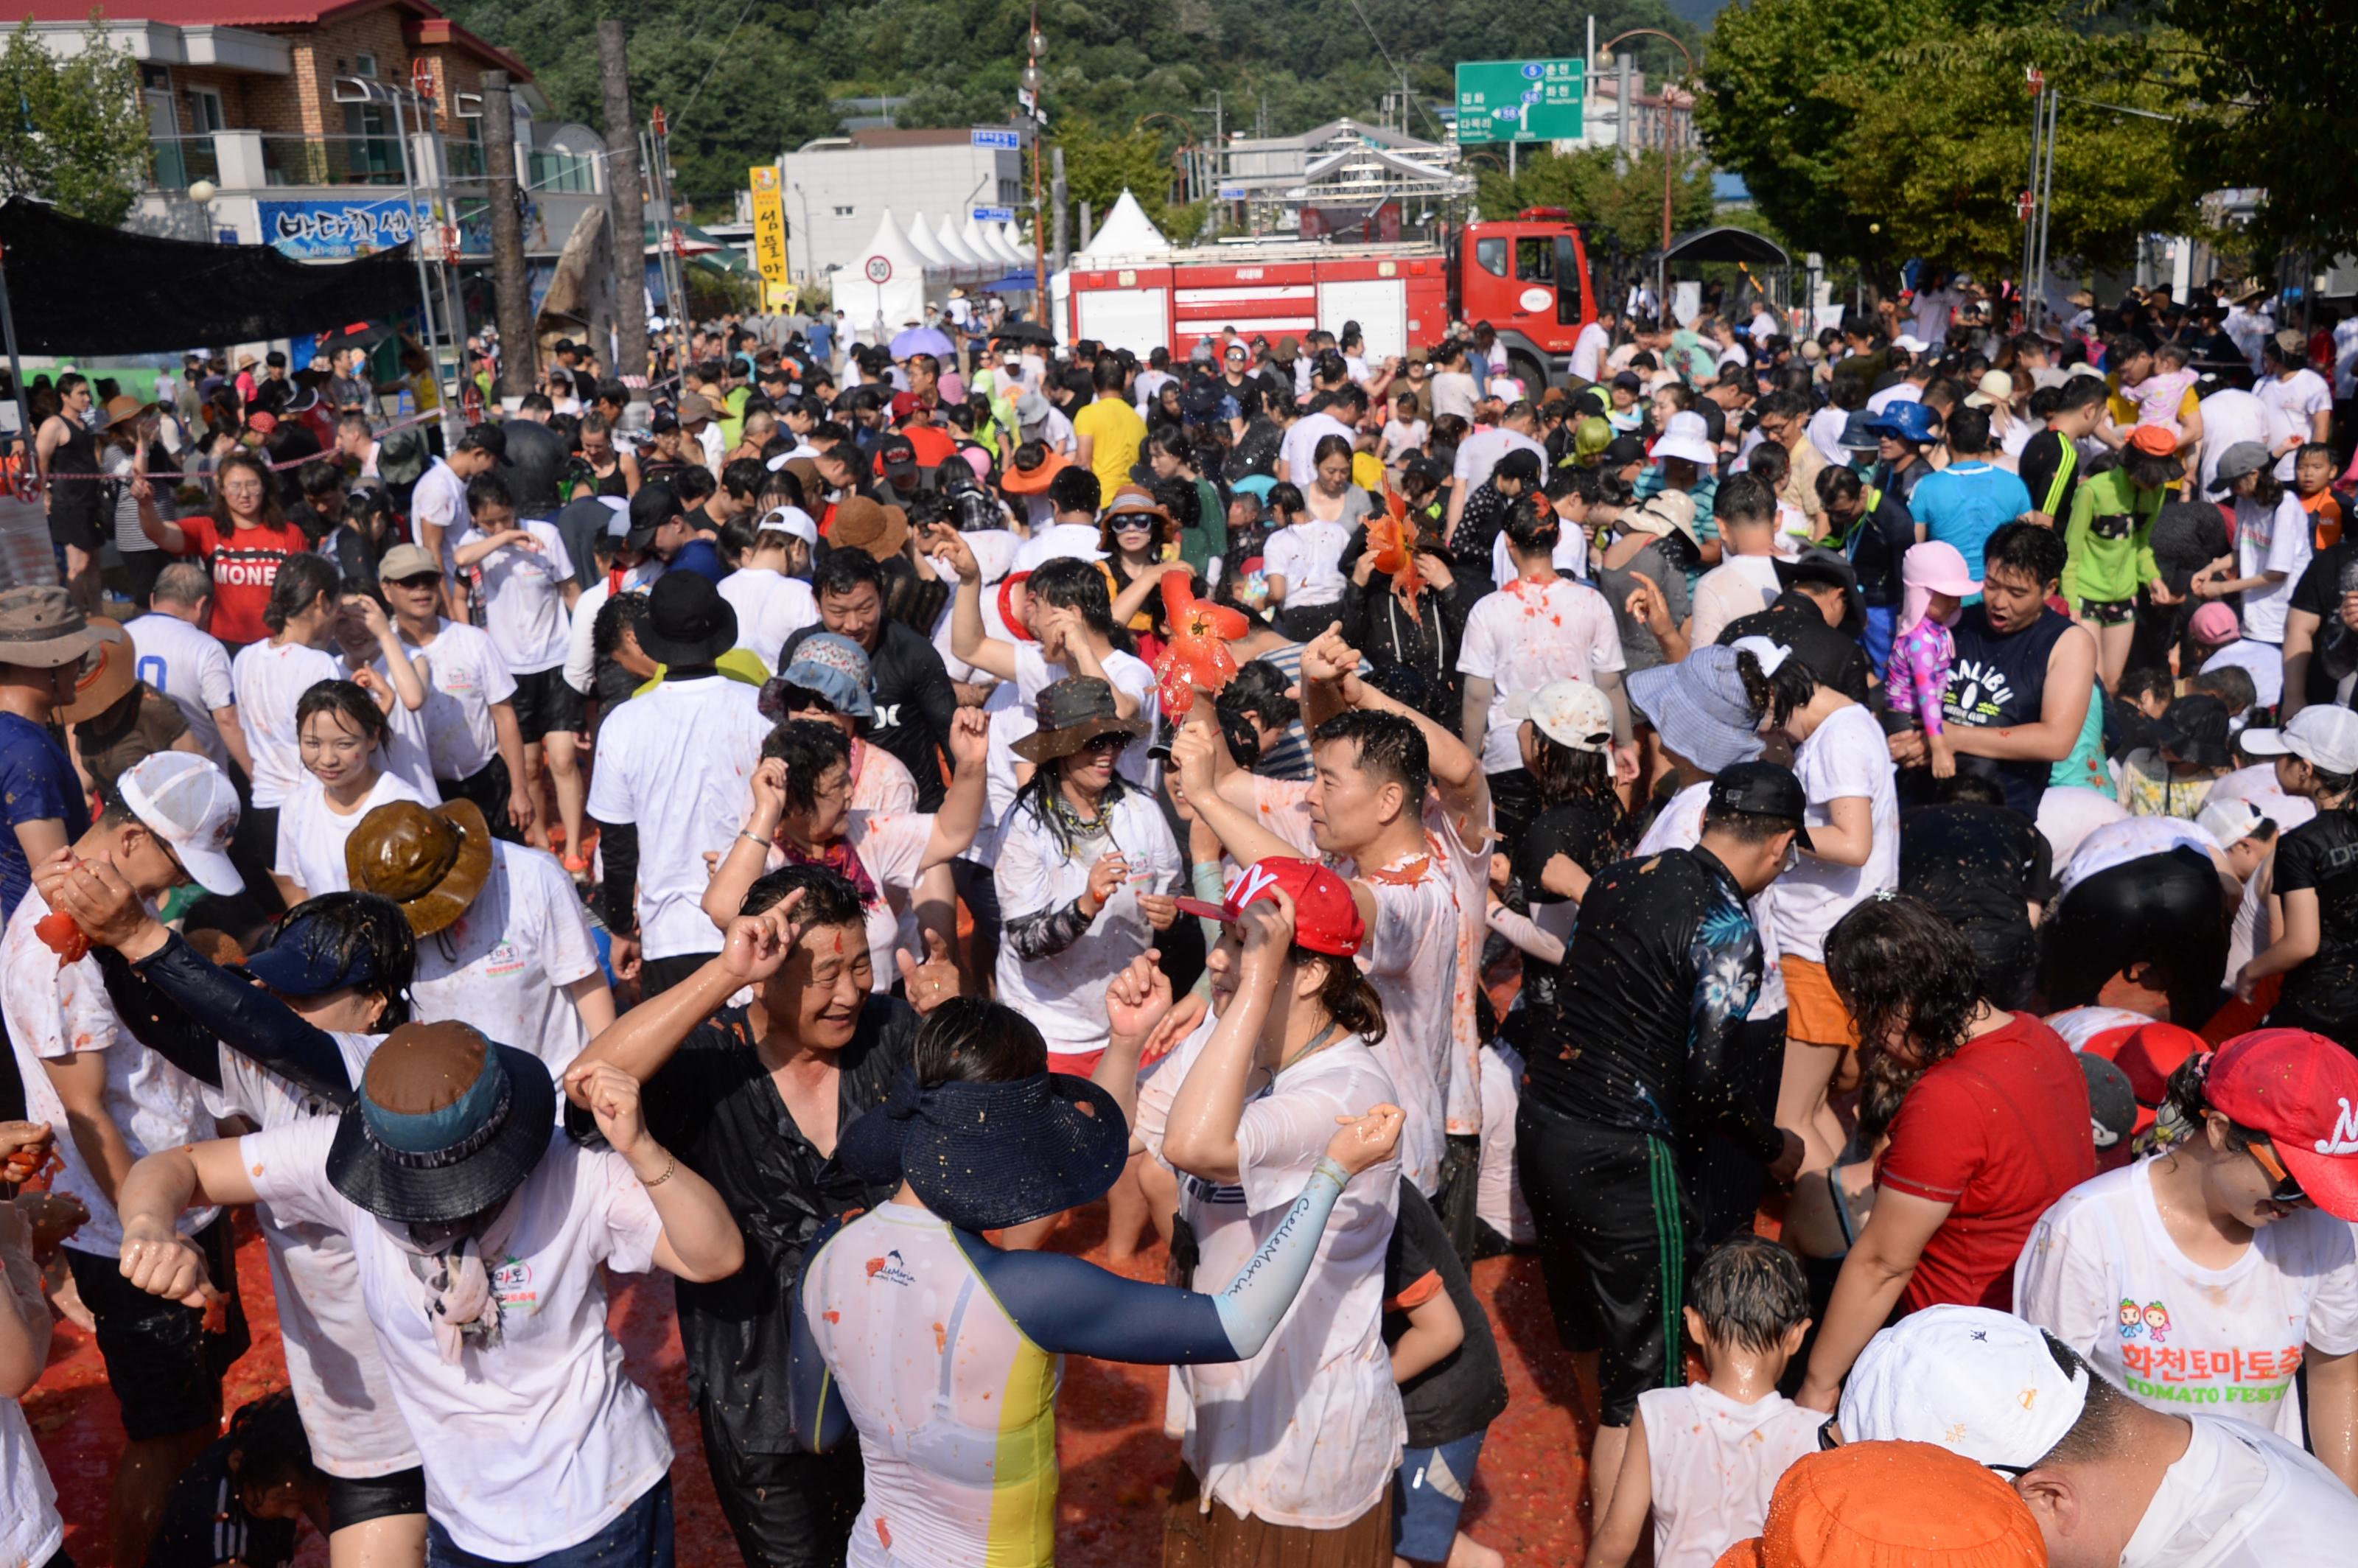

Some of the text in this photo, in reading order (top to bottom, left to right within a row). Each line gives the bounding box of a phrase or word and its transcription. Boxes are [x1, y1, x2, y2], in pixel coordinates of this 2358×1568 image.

[760, 209, 784, 283] 섬뜰마
[871, 262, 886, 276] 30
[214, 563, 278, 587] MONE
[1227, 1197, 1309, 1298] CielleMarin
[495, 1267, 525, 1284] 마토
[2121, 1343, 2303, 1383] 화천토마토축
[2124, 1374, 2288, 1404] TOMATO FEST
